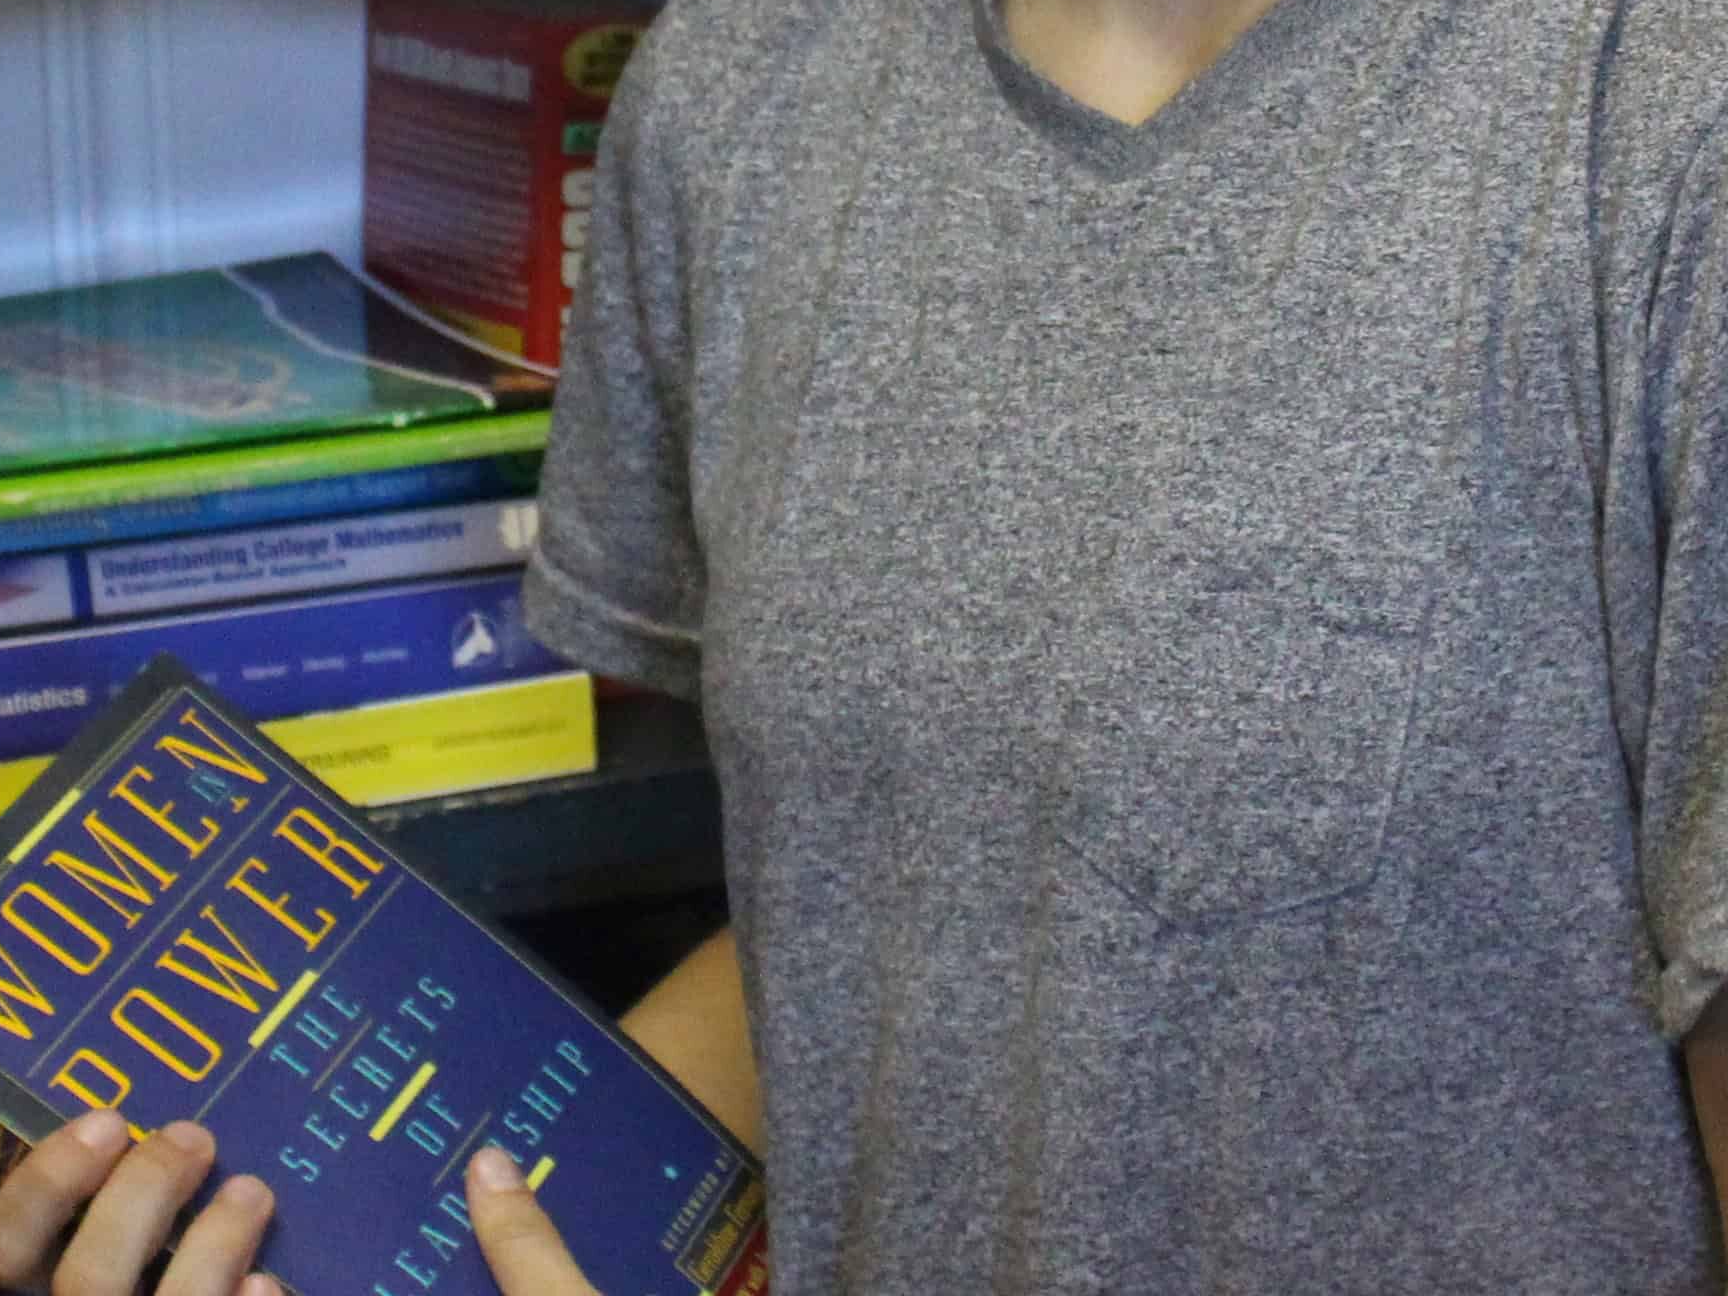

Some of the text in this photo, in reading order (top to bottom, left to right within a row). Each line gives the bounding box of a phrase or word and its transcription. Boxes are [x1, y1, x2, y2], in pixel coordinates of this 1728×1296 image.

[100, 521, 465, 580] Understanding College Mathematics
[48, 806, 386, 1145] POWER
[270, 984, 362, 1078] THE
[278, 976, 459, 1184] SECRETS
[405, 1092, 466, 1157] OF
